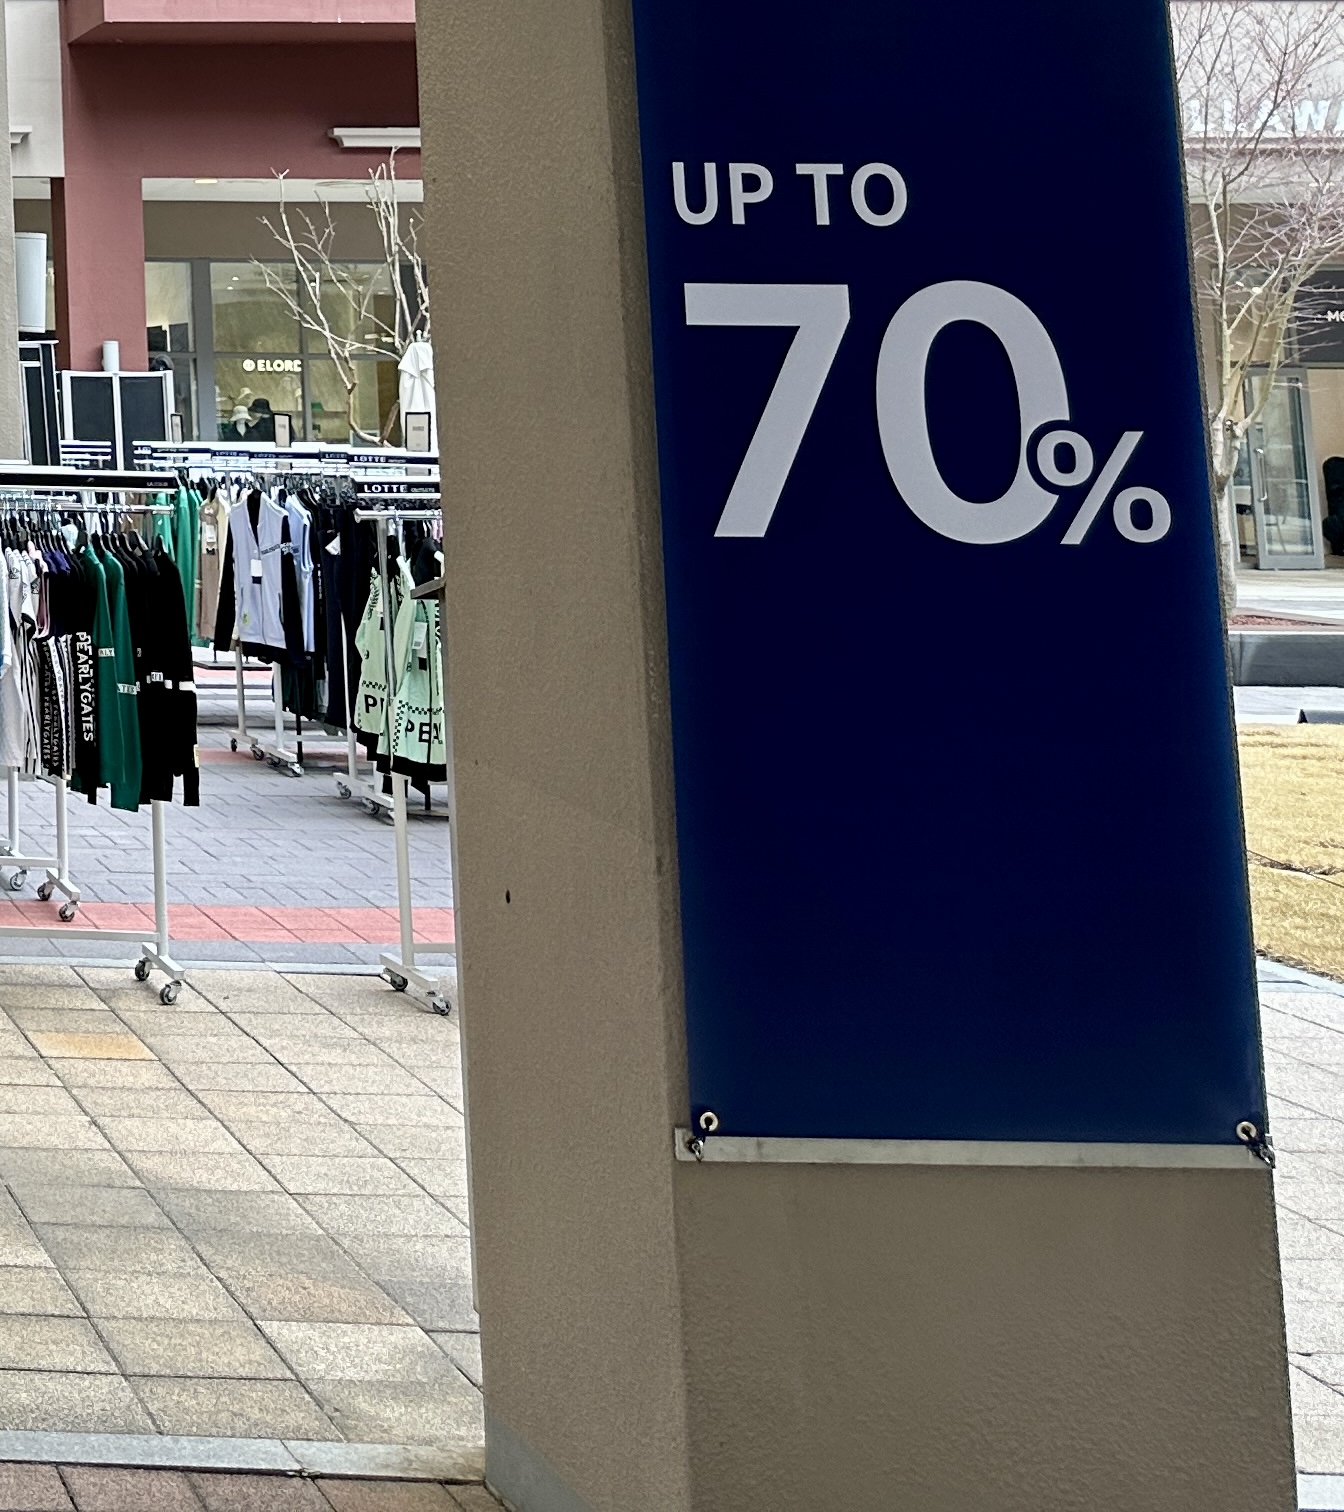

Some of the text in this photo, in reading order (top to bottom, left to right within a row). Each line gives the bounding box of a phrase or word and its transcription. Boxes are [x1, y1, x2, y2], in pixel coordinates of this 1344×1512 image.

[672, 162, 908, 227] UP TO
[684, 280, 1171, 545] 70%
[364, 484, 408, 493] LOTTE
[76, 632, 94, 741] PEARLYGATES
